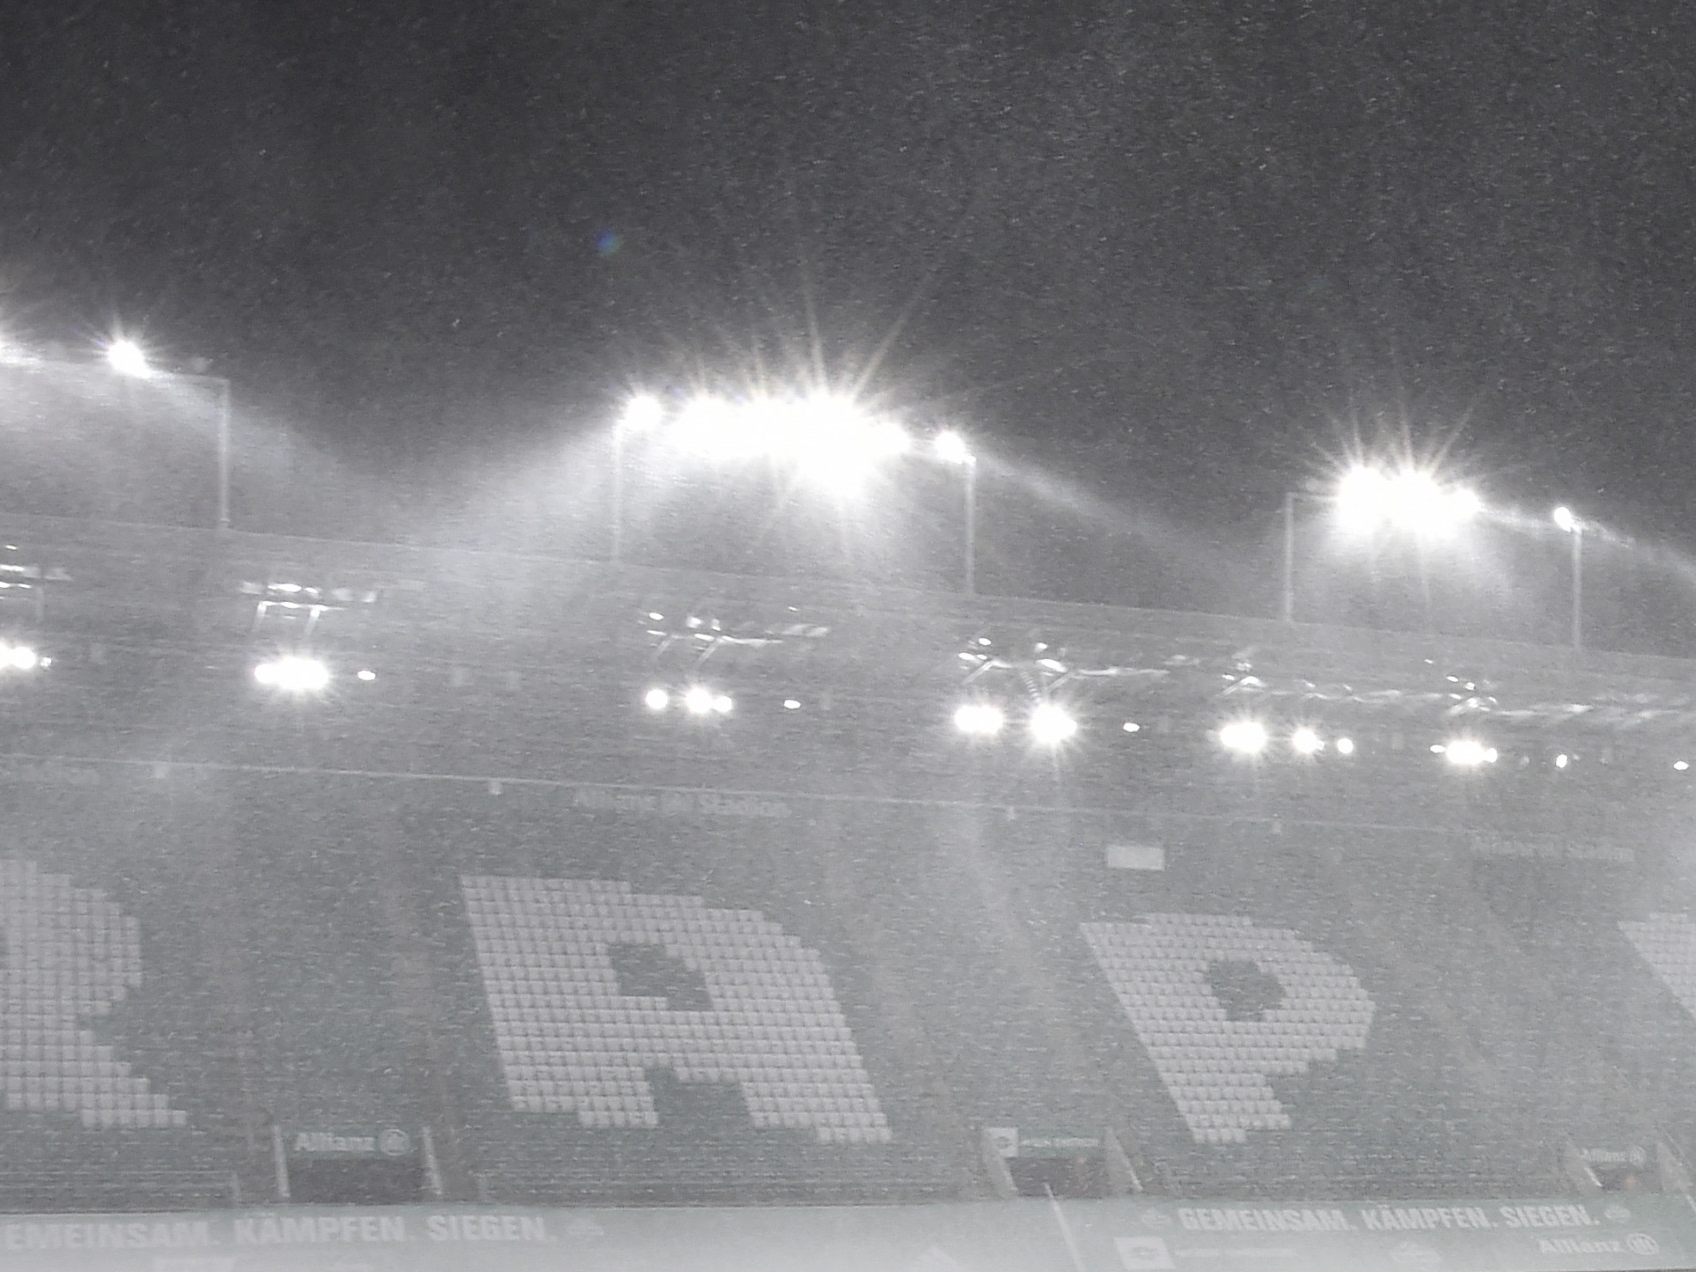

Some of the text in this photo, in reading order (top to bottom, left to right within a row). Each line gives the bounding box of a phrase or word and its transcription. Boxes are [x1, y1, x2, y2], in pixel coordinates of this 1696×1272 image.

[1178, 1203, 1600, 1231] GEMEINSAM. KÄMPFEN. SIEGEN.
[4, 1220, 220, 1249] EMEINSAM.
[1539, 1239, 1625, 1256] Allianz
